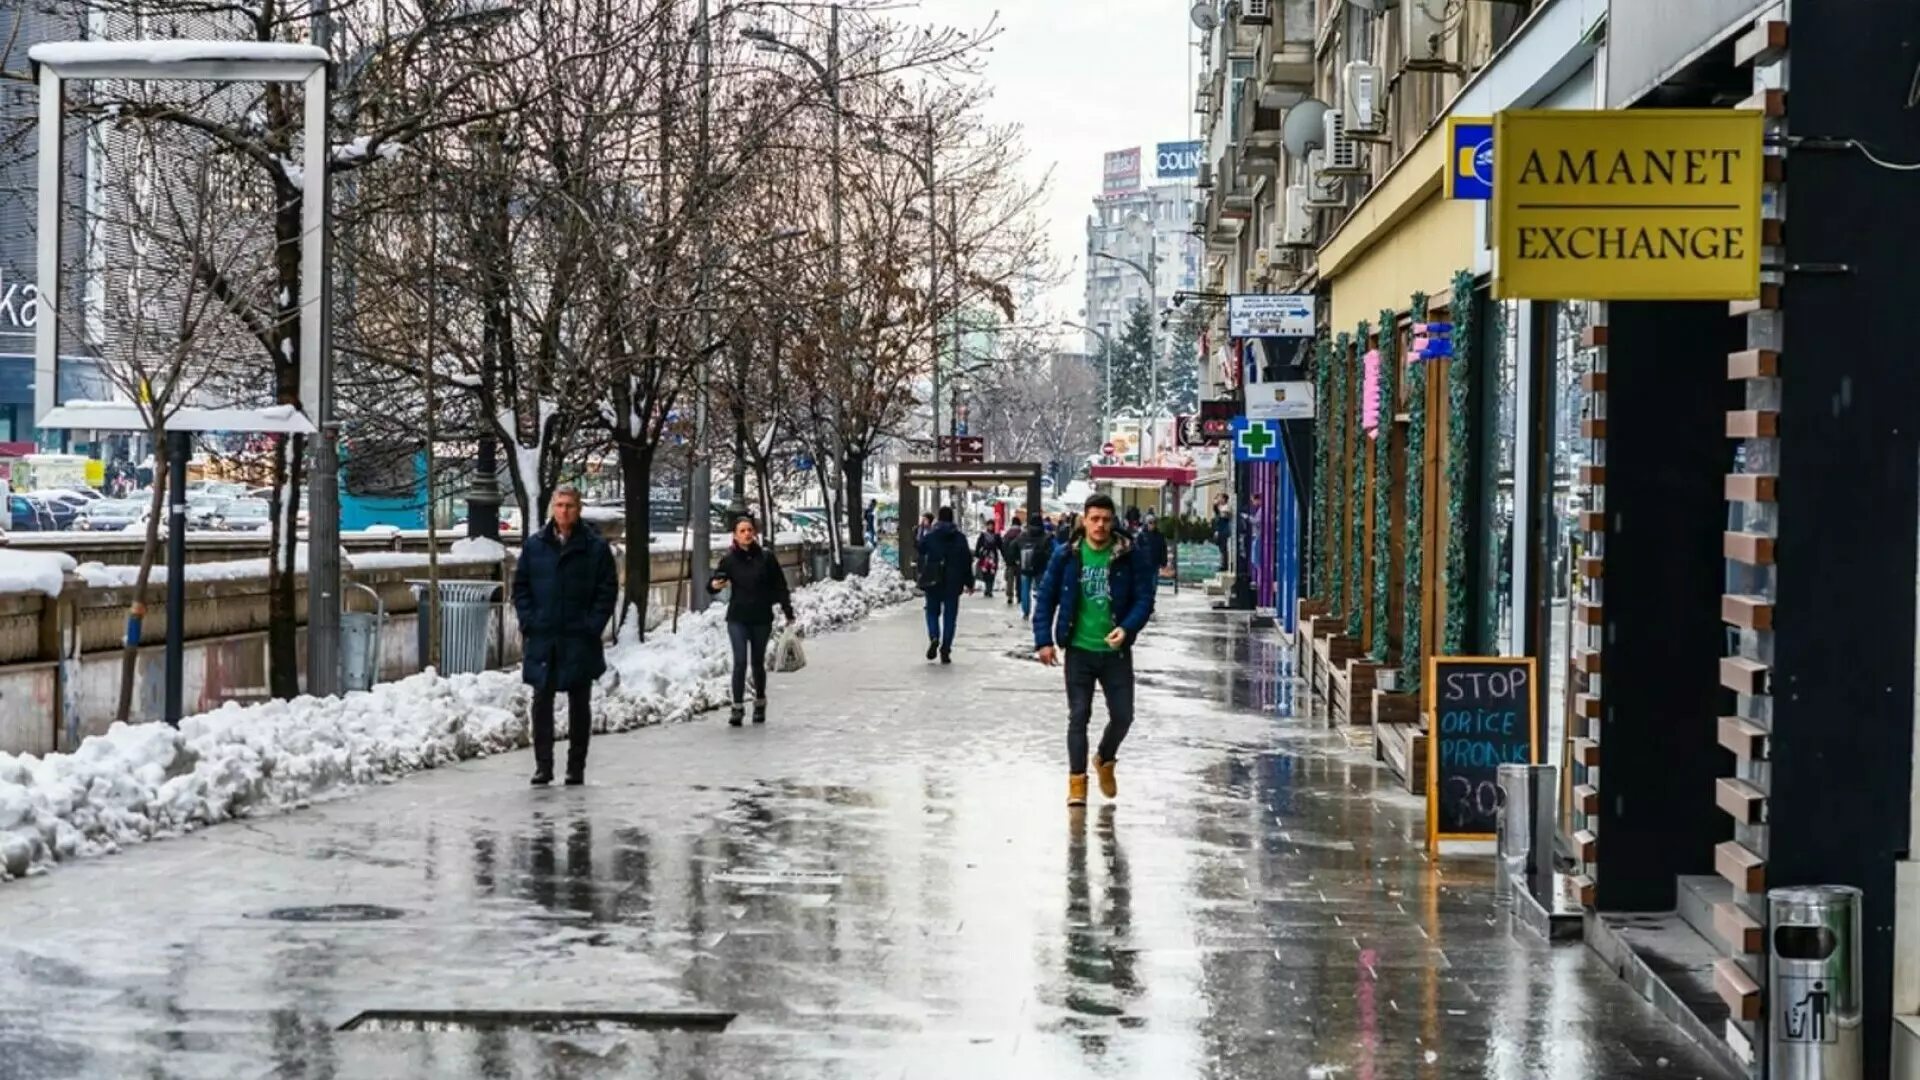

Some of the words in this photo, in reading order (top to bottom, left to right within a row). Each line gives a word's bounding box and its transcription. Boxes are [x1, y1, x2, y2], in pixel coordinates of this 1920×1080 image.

[1517, 148, 1741, 185] AMANET
[1516, 226, 1744, 260] EXCHANGE
[1232, 311, 1251, 319] LAW
[1255, 310, 1287, 318] OFFICE
[1444, 668, 1527, 700] STOP
